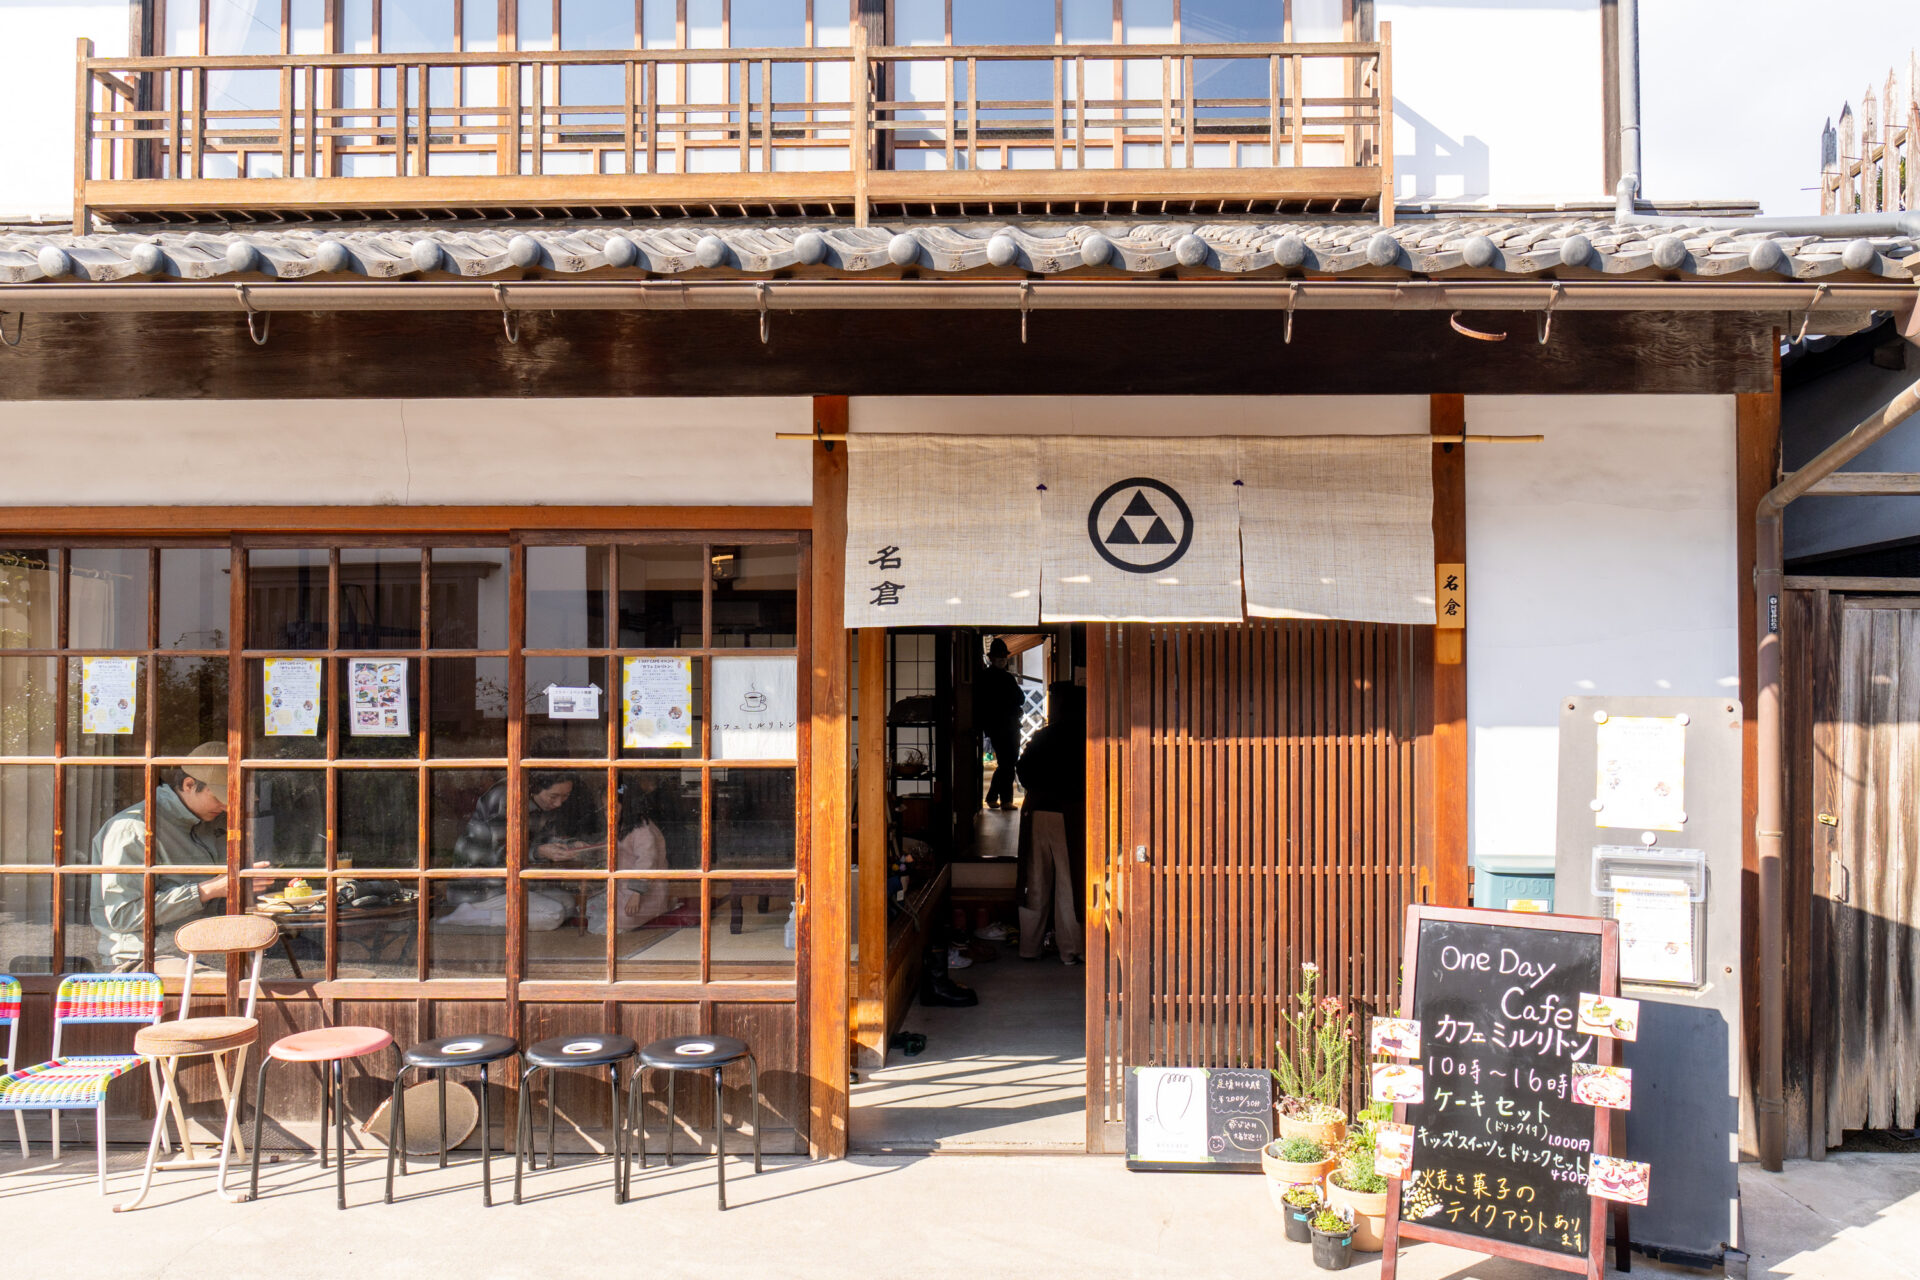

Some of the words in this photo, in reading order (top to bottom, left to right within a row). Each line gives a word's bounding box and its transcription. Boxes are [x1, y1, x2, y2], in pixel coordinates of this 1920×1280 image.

[868, 545, 906, 607] 名倉
[1443, 574, 1461, 616] 名倉
[1503, 879, 1554, 896] POST
[1441, 945, 1491, 971] One
[1499, 948, 1557, 989] Day
[1501, 986, 1573, 1030] Cafe
[1422, 1168, 1536, 1203] 焼き菓子の
